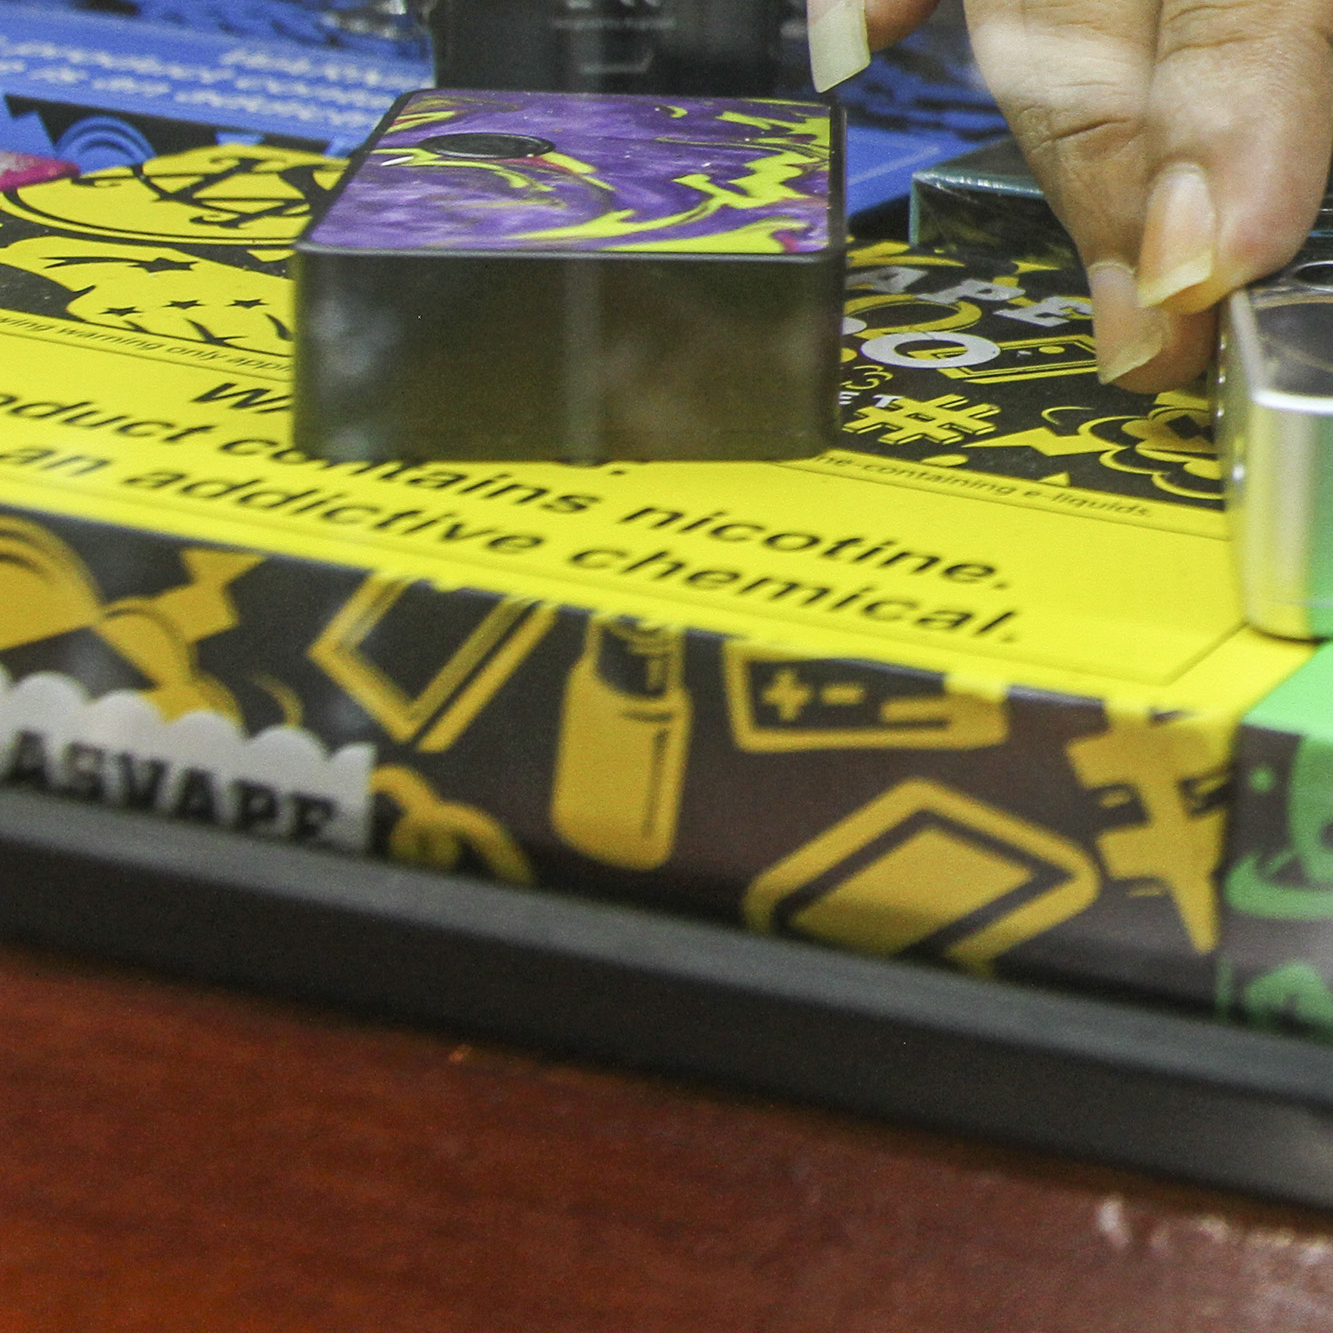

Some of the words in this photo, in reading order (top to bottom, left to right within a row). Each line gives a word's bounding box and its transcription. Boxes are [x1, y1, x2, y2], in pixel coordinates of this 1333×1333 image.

[57, 326, 164, 352] warning
[121, 469, 546, 555] addictive
[567, 548, 1019, 644] chemical.
[616, 505, 1011, 590] nicotine.
